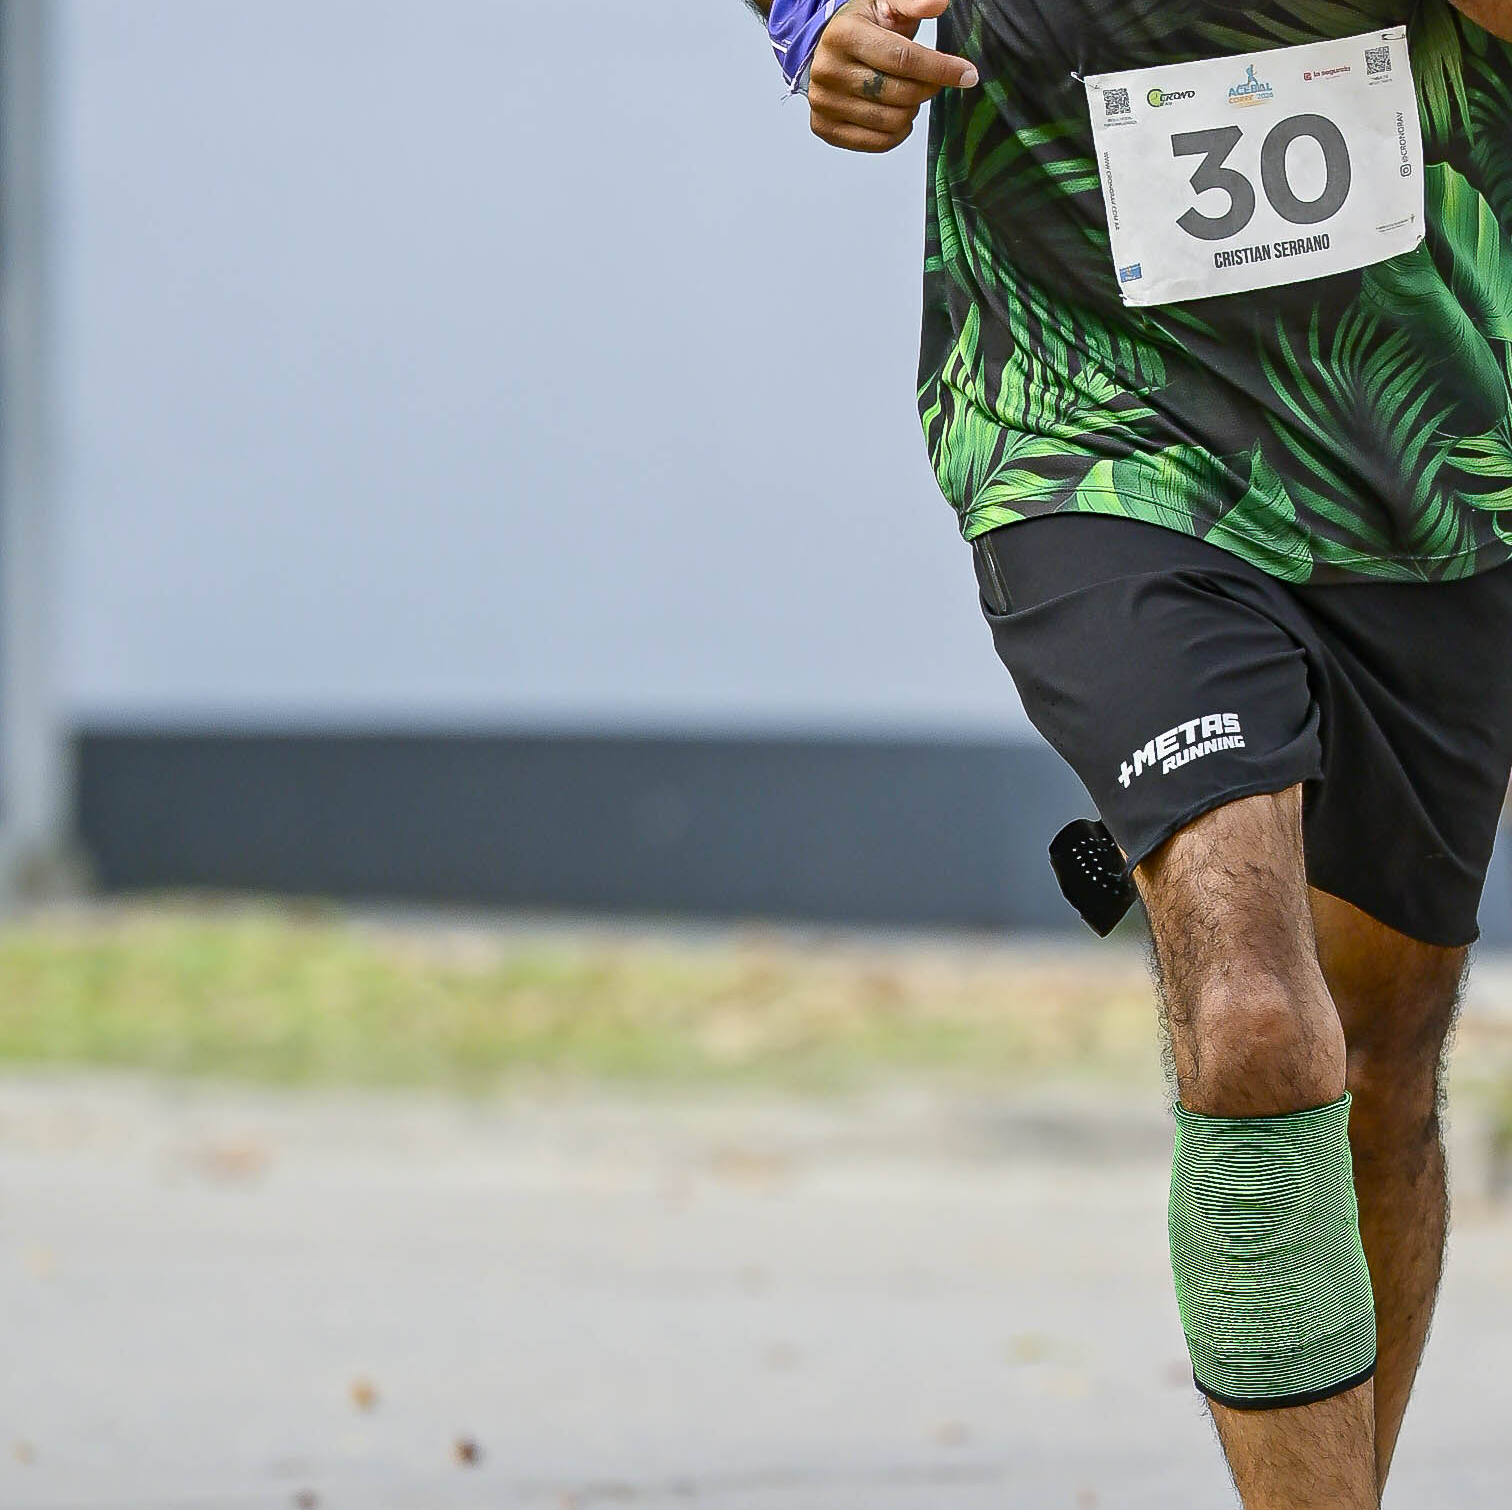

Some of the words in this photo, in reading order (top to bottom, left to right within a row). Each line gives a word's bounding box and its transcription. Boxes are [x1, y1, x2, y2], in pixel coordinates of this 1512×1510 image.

[1170, 113, 1352, 241] 30
[1214, 244, 1272, 269] CRISTIAN
[1273, 233, 1330, 259] SERRANO
[1162, 735, 1246, 775] RUNNING
